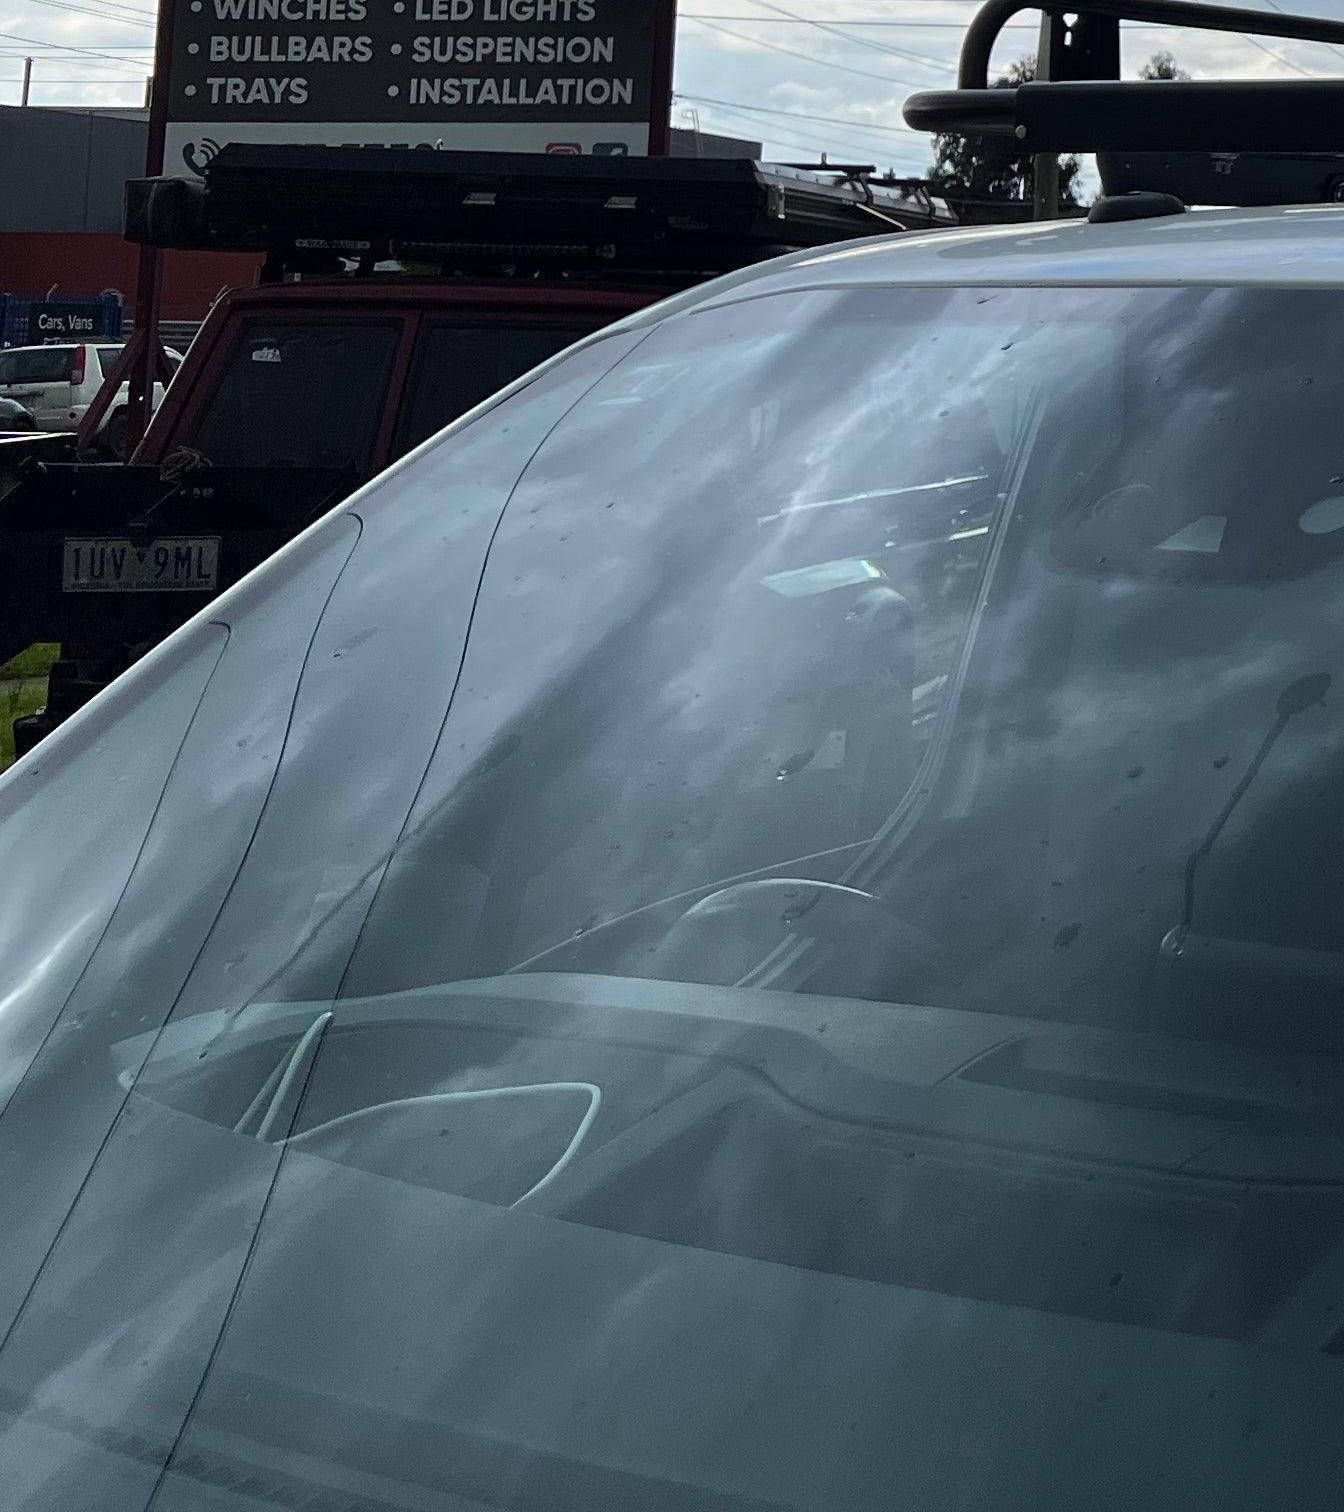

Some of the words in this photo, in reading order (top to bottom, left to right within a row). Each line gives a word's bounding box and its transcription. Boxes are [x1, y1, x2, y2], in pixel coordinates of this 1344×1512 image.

[209, 35, 373, 63] BULLBARS
[412, 36, 614, 64] SUSPENSION
[206, 77, 309, 105] TRAYS
[409, 78, 633, 105] INSTALLATION
[68, 314, 93, 330] Vans
